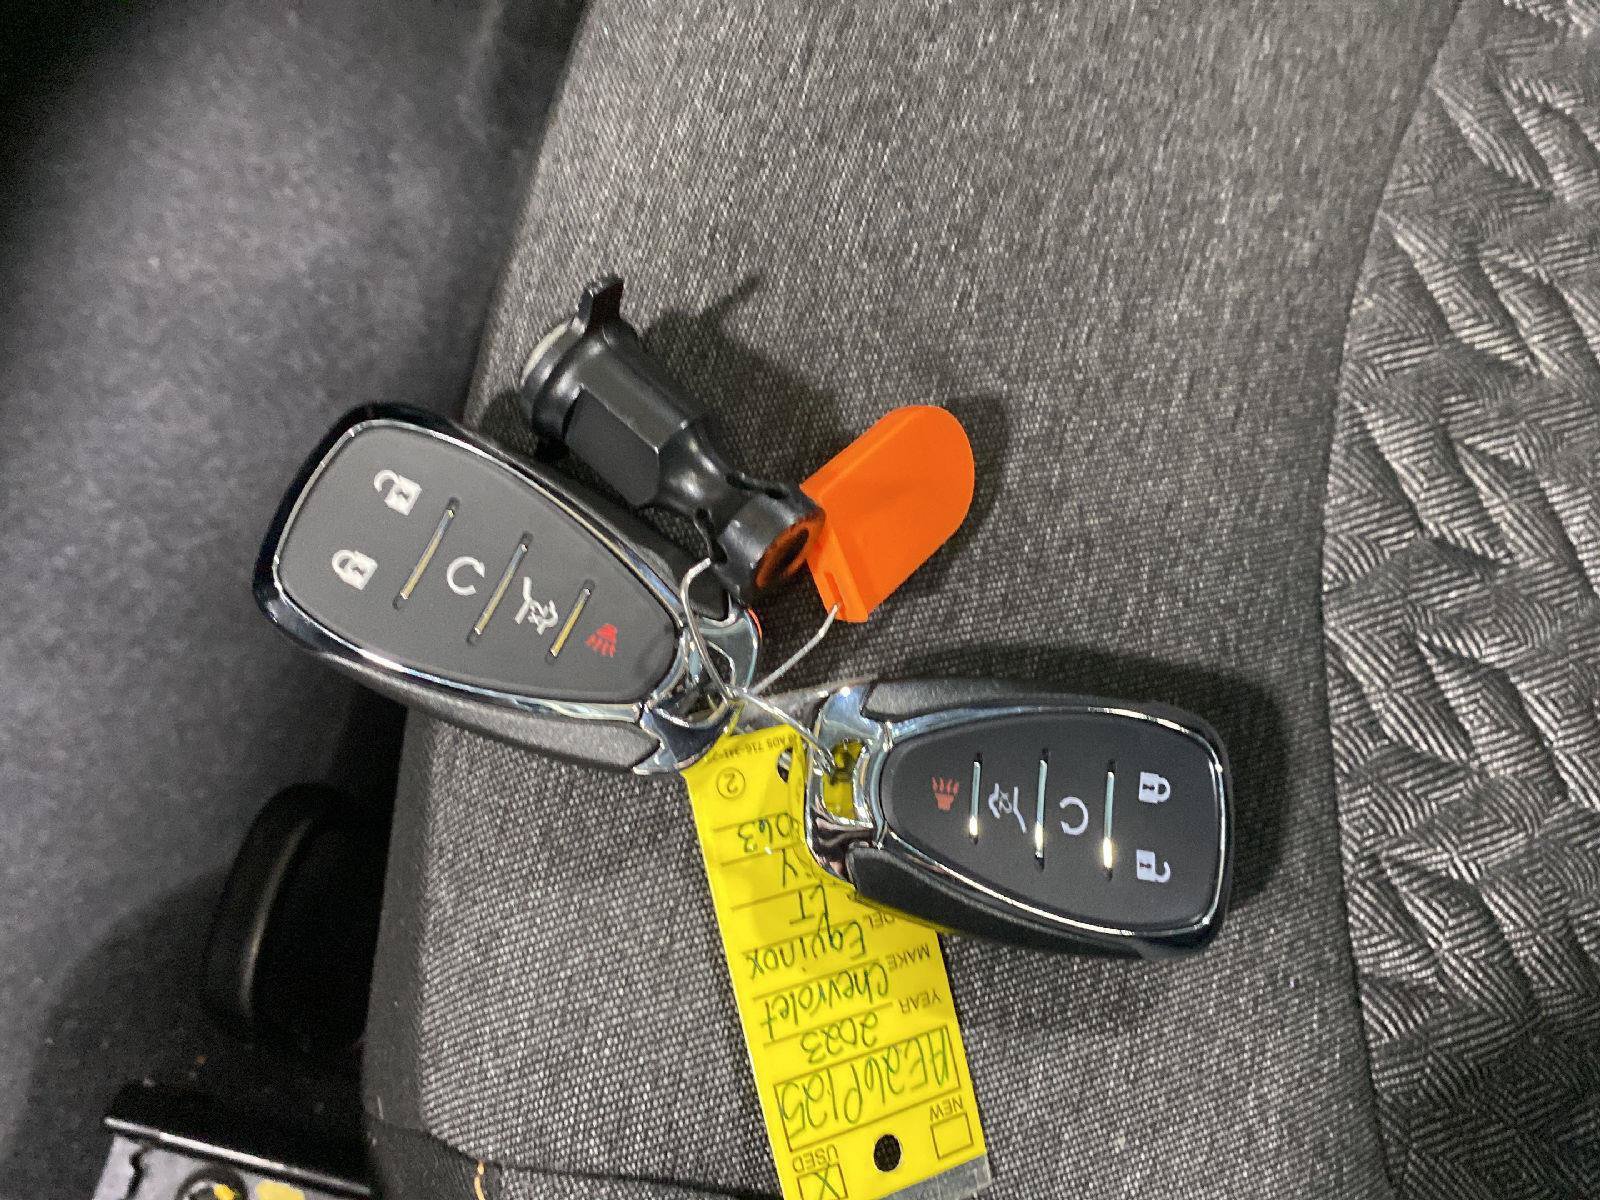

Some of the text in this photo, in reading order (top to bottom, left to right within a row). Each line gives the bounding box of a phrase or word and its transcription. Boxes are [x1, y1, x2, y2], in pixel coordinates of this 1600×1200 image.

[749, 913, 866, 980] Equinox
[886, 946, 930, 971] MAKE
[760, 961, 889, 1041] Chevrolet
[898, 988, 942, 1014] YEAR
[799, 1011, 878, 1064] 2023
[929, 1094, 964, 1121] NEW
[792, 1144, 839, 1173] USED
